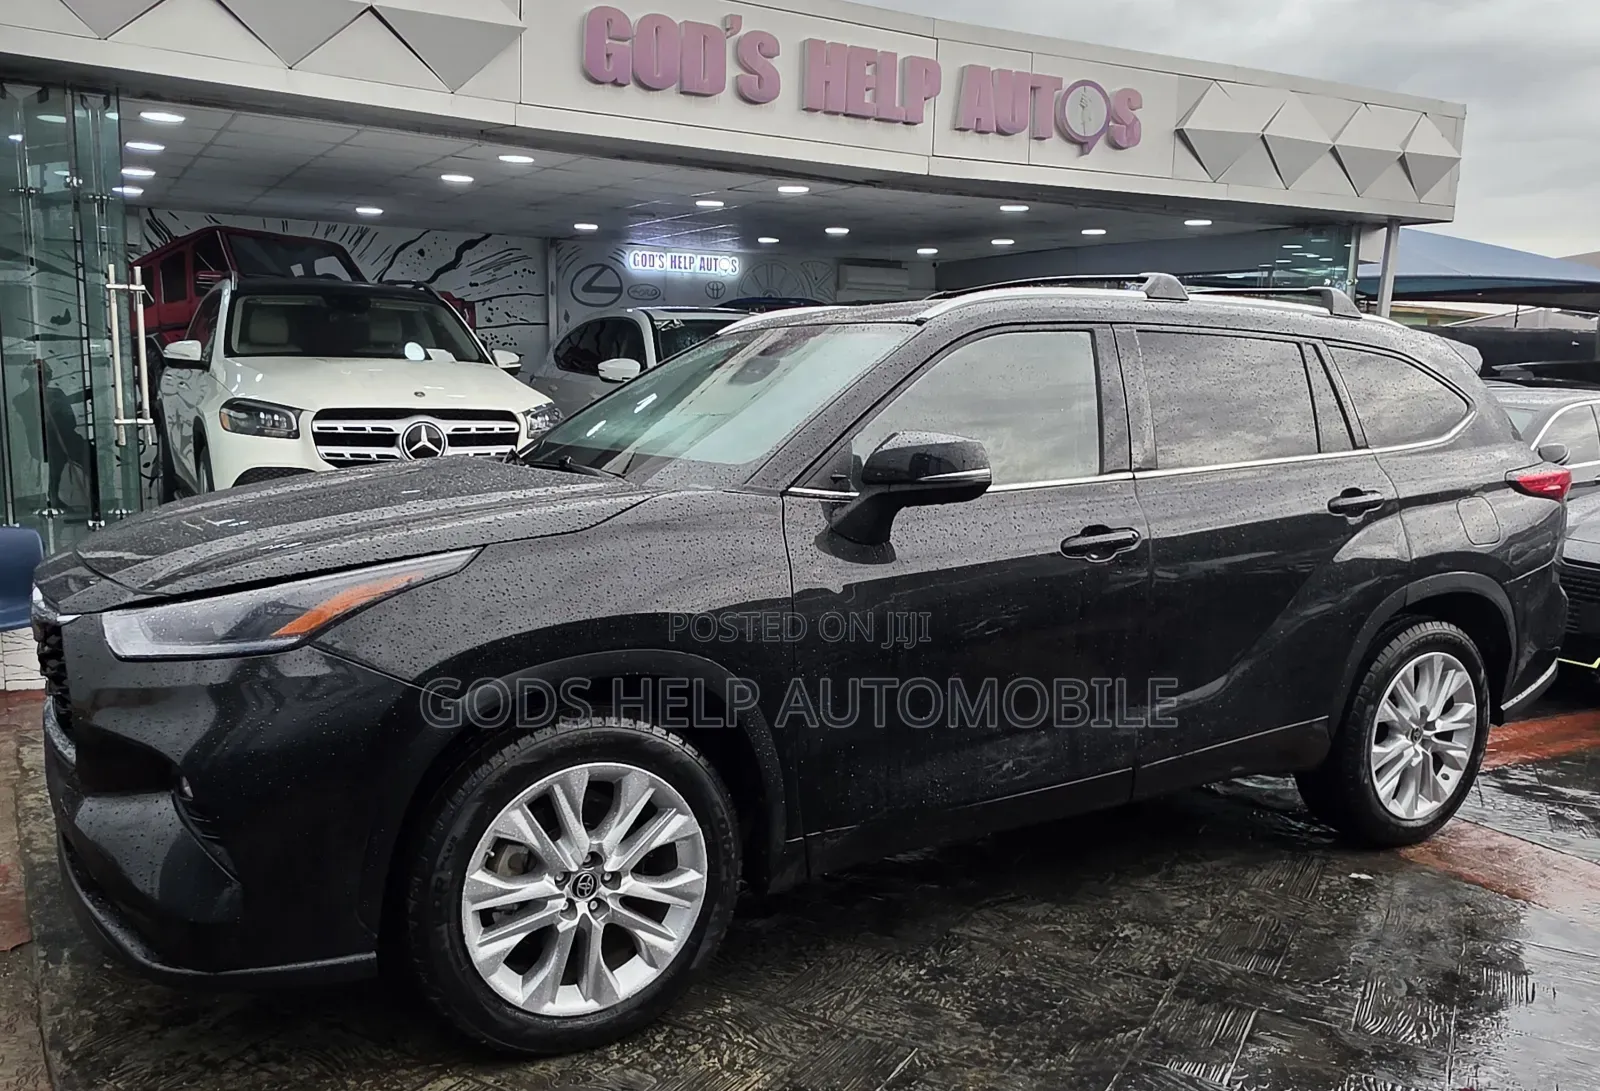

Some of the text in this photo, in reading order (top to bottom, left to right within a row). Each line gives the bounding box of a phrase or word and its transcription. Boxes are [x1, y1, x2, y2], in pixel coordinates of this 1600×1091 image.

[582, 5, 1144, 157] GOD'S HELP AUTOS
[632, 252, 738, 274] GOD'S HELP AUTOS
